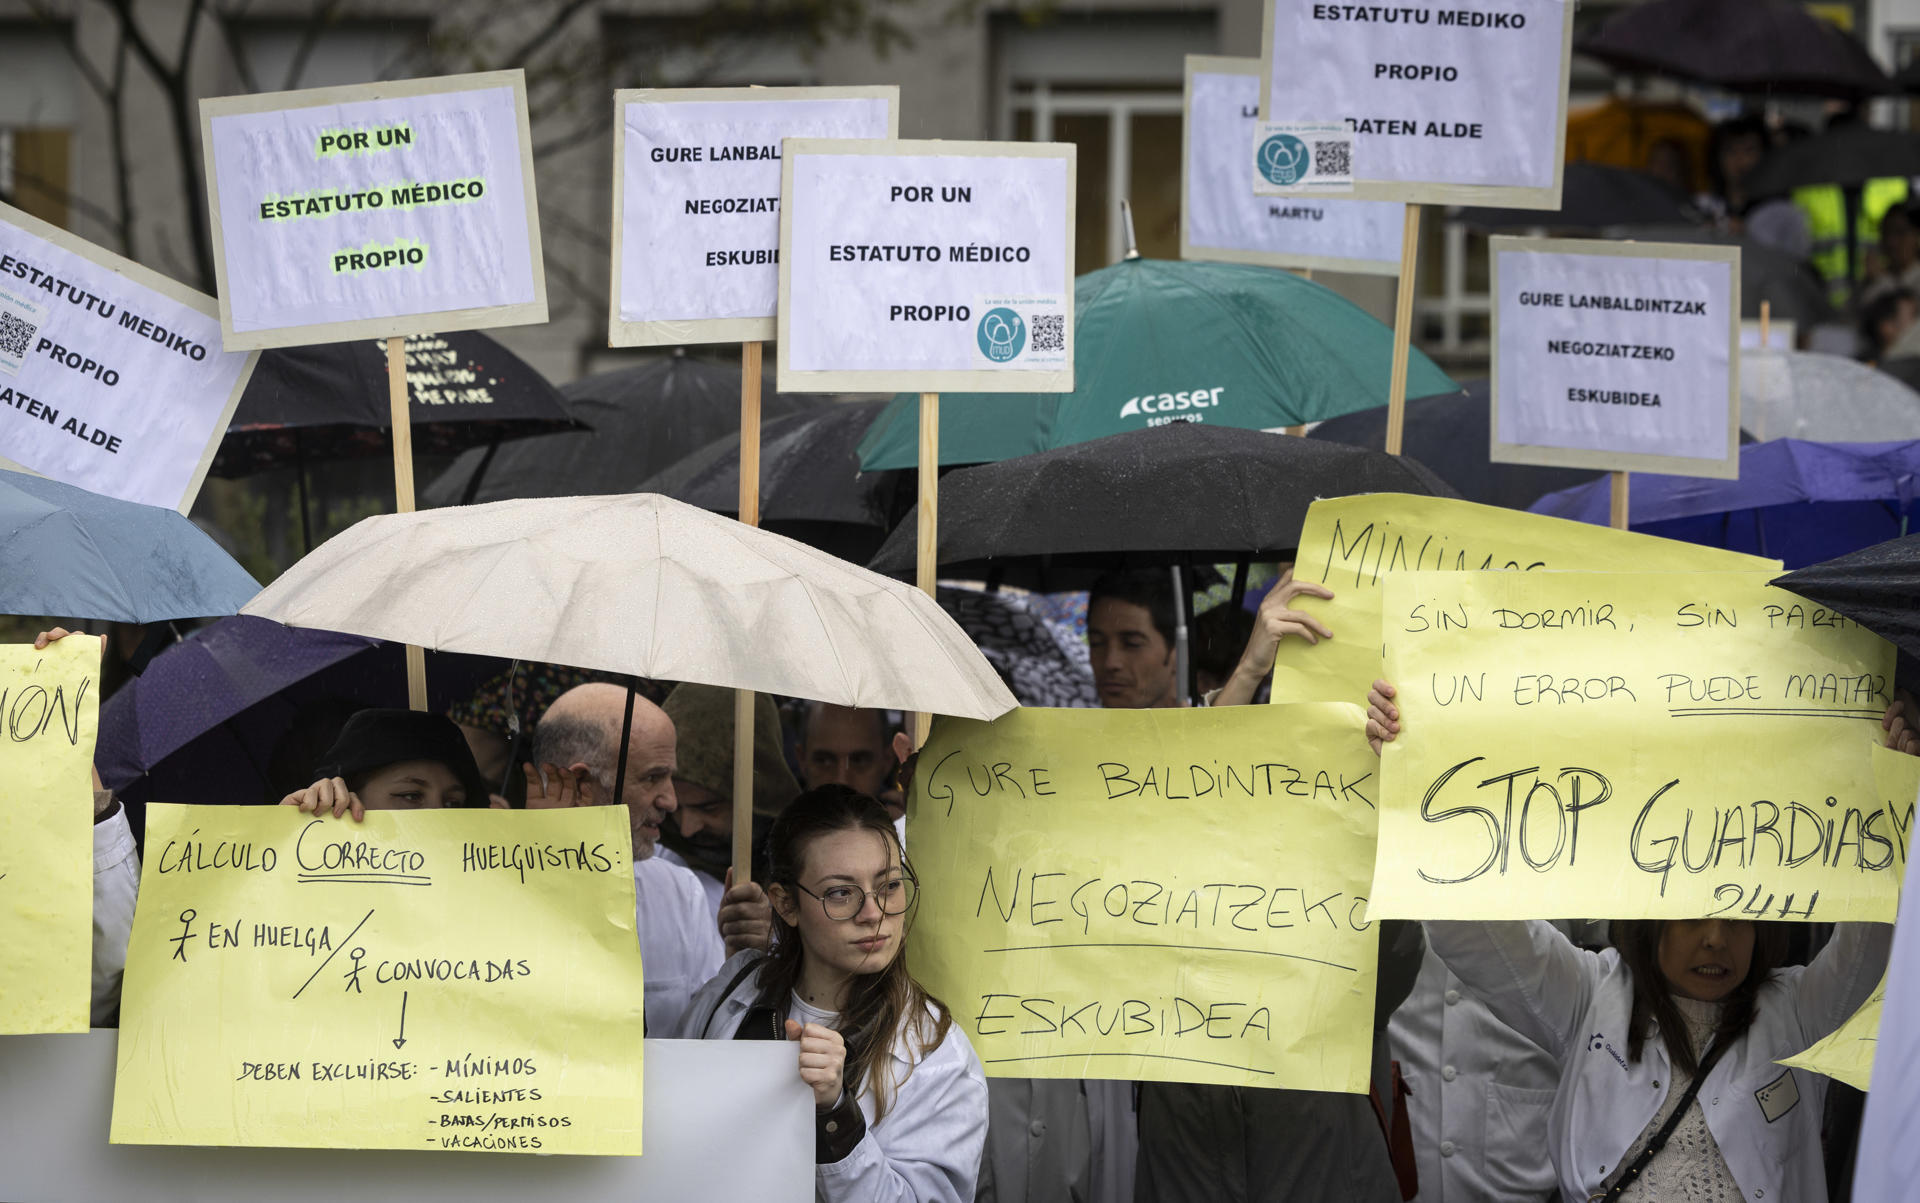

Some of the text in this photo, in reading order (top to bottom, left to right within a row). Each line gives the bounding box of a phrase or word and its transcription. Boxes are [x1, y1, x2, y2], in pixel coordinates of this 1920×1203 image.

[1313, 4, 1526, 29] ESTATUTU MEDIKO
[1374, 64, 1458, 82] PROPIO
[321, 128, 410, 153] POR UN
[1424, 122, 1483, 139] ALDE
[651, 146, 781, 163] GURE LANBAL
[260, 181, 484, 220] ESTATUTO MÉDICO
[685, 197, 781, 214] NEGOZIAT
[891, 186, 972, 202] POR UN
[334, 248, 424, 272] PROPIO
[829, 242, 1031, 262] ESTATUTO MÉDICO
[1, 254, 207, 361] ESTATUTU MEDIKO
[890, 306, 971, 322] PROPIO
[1519, 291, 1706, 316] GURE LANBALDINTZAK
[36, 338, 120, 387] PROPIO
[1548, 340, 1675, 361] NEGOZIATZEKO
[1141, 387, 1224, 413] caser
[1568, 388, 1662, 407] ESKUBIDEA
[0, 385, 122, 454] ATEN ALDE
[1405, 599, 1859, 633] SIN DORMIR, SIN PARA
[1432, 672, 1891, 706] UN ERROR PUEDE MATAR
[927, 750, 1376, 817] GURE BALDINTZAK
[1418, 757, 1613, 885] STOP
[1629, 779, 1894, 897] GUARDIAS
[158, 829, 277, 874] CÁLCULO
[296, 820, 425, 873] CORRECTO
[976, 865, 1371, 935] NEGOZIATZEKO
[208, 919, 333, 953] EN HUELGA
[375, 958, 531, 984] CONVOCADAS
[975, 994, 1271, 1041] ESKUBIDEA
[236, 1061, 301, 1081] DEBEN
[312, 1061, 418, 1081] EXCLUIRSE:
[445, 1053, 537, 1078] MÍNIMOS
[441, 1134, 543, 1150] VACACIONES
